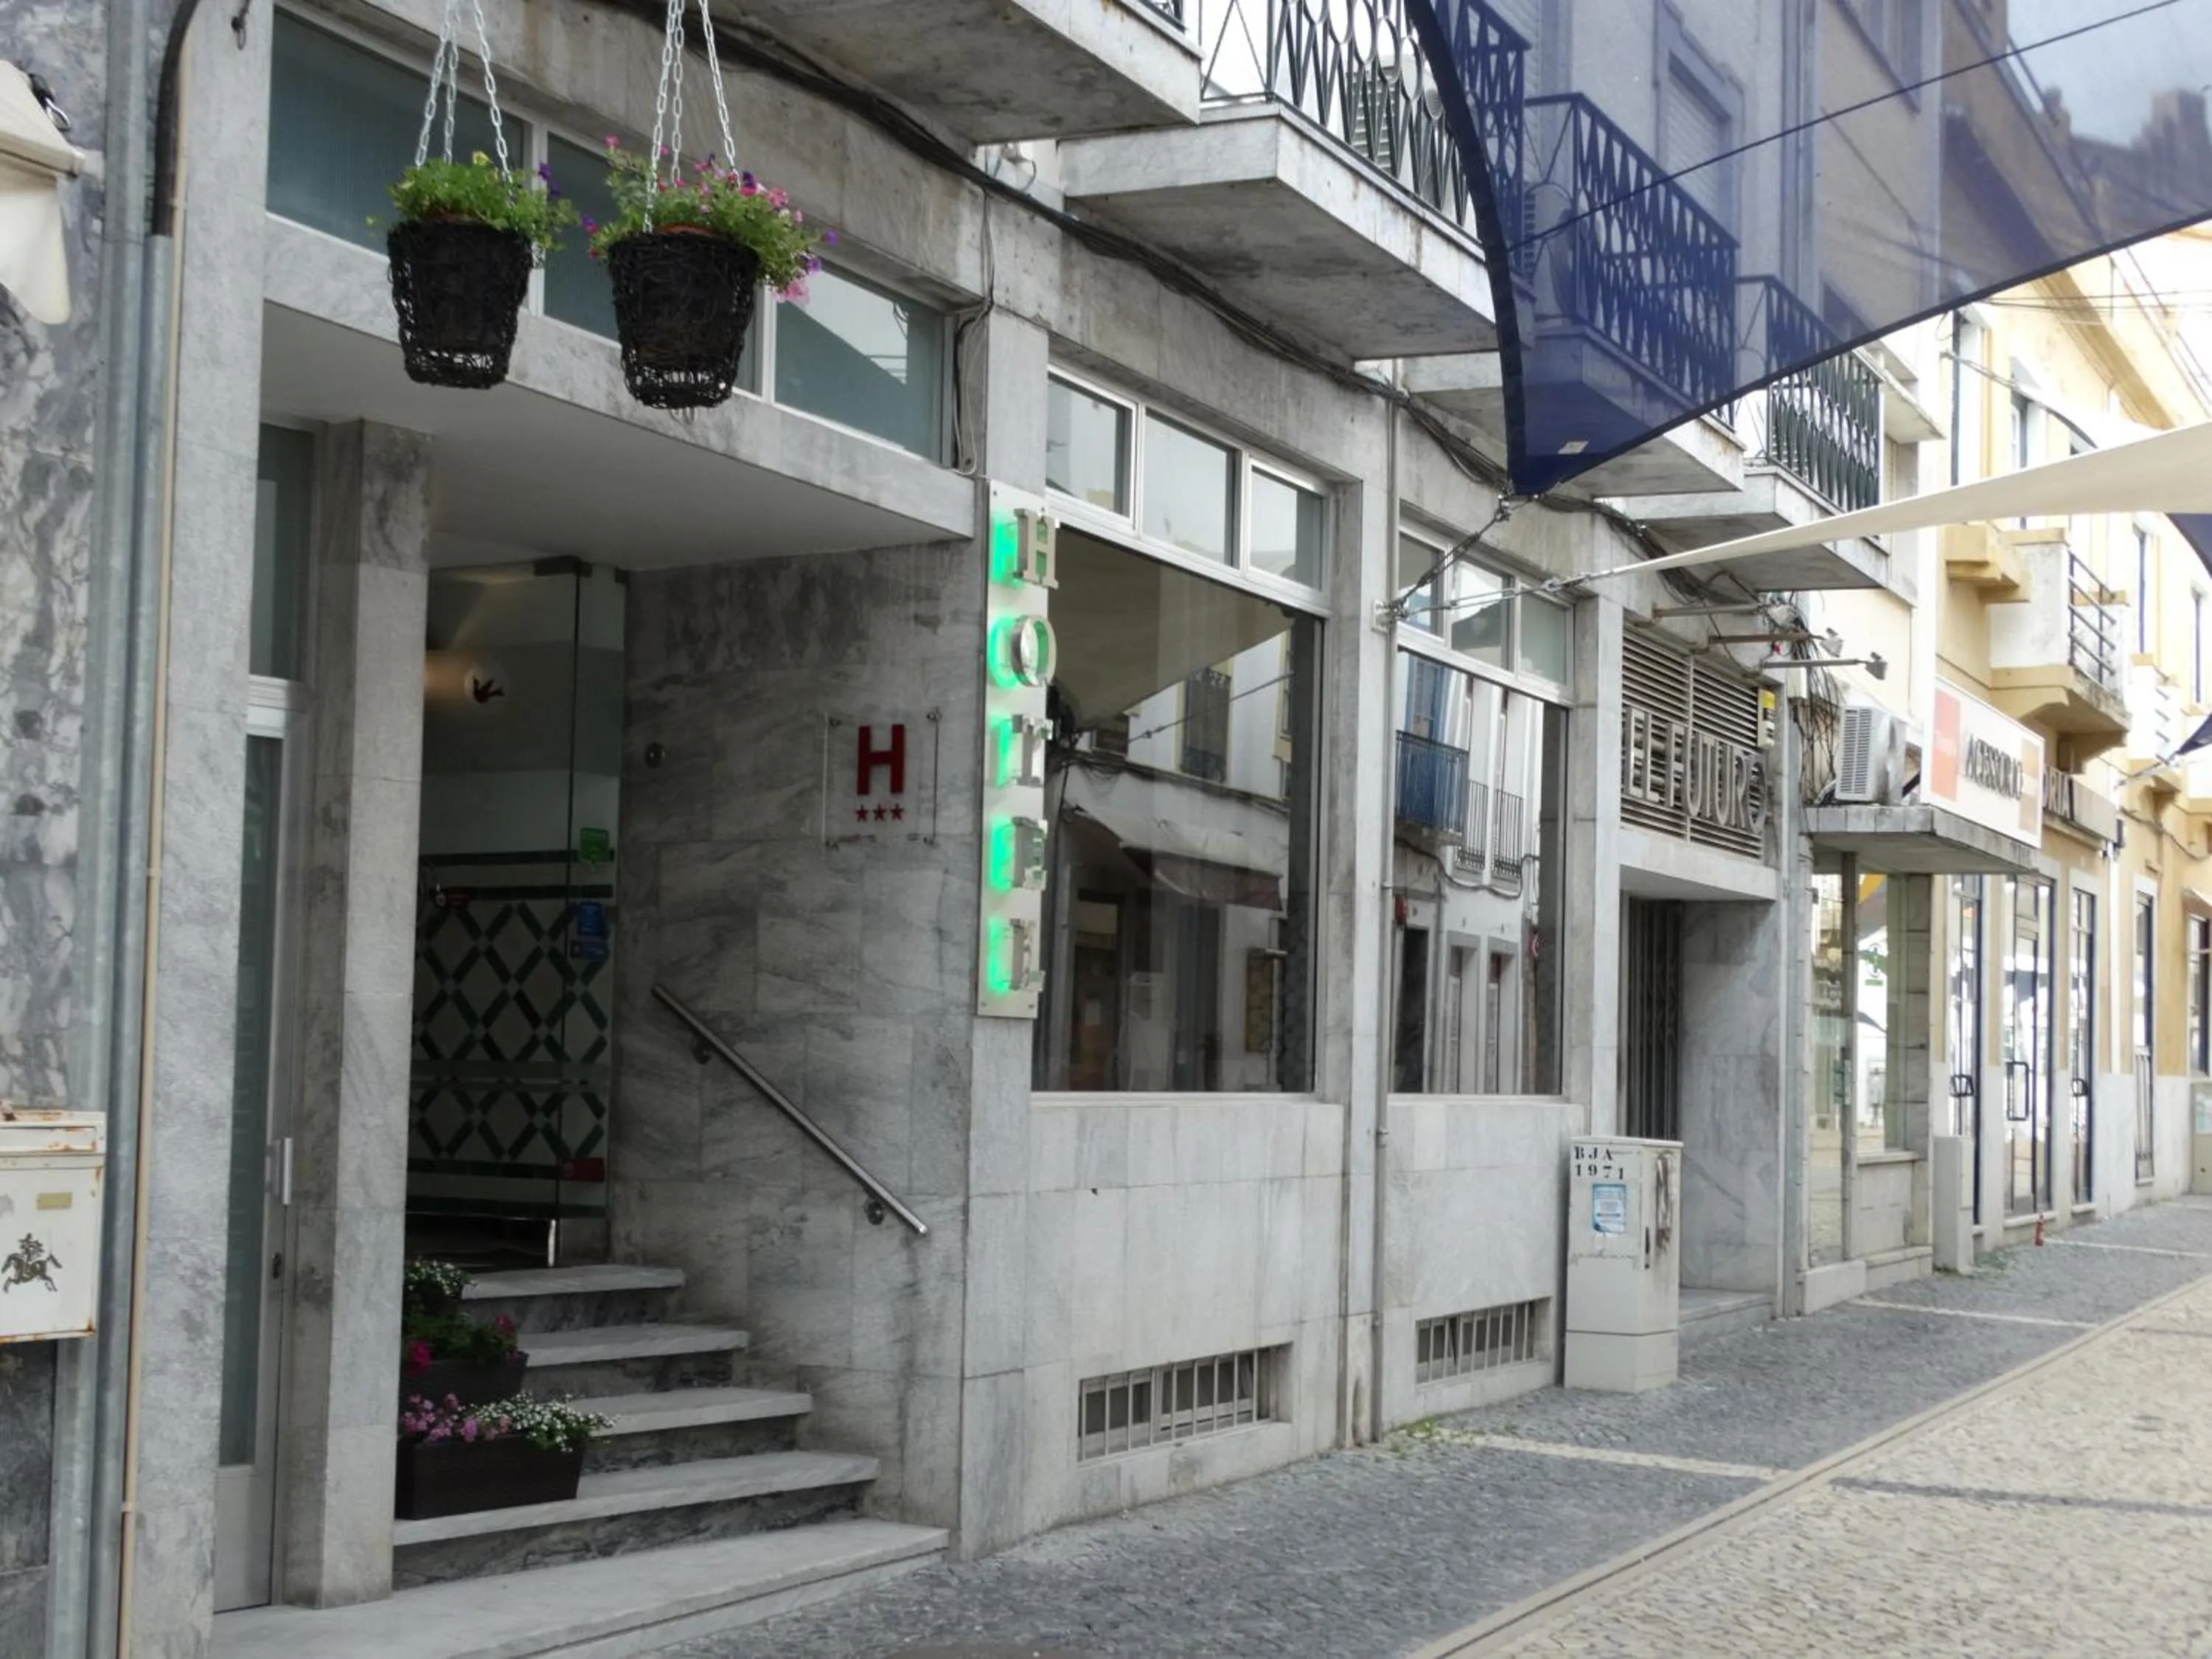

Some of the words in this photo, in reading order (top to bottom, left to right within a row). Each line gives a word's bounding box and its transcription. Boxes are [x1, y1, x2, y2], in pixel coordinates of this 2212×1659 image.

[856, 723, 905, 796] H
[1004, 508, 1060, 992] HOTEL
[1574, 1146, 1613, 1161] BJA
[1576, 1164, 1624, 1180] 1971
